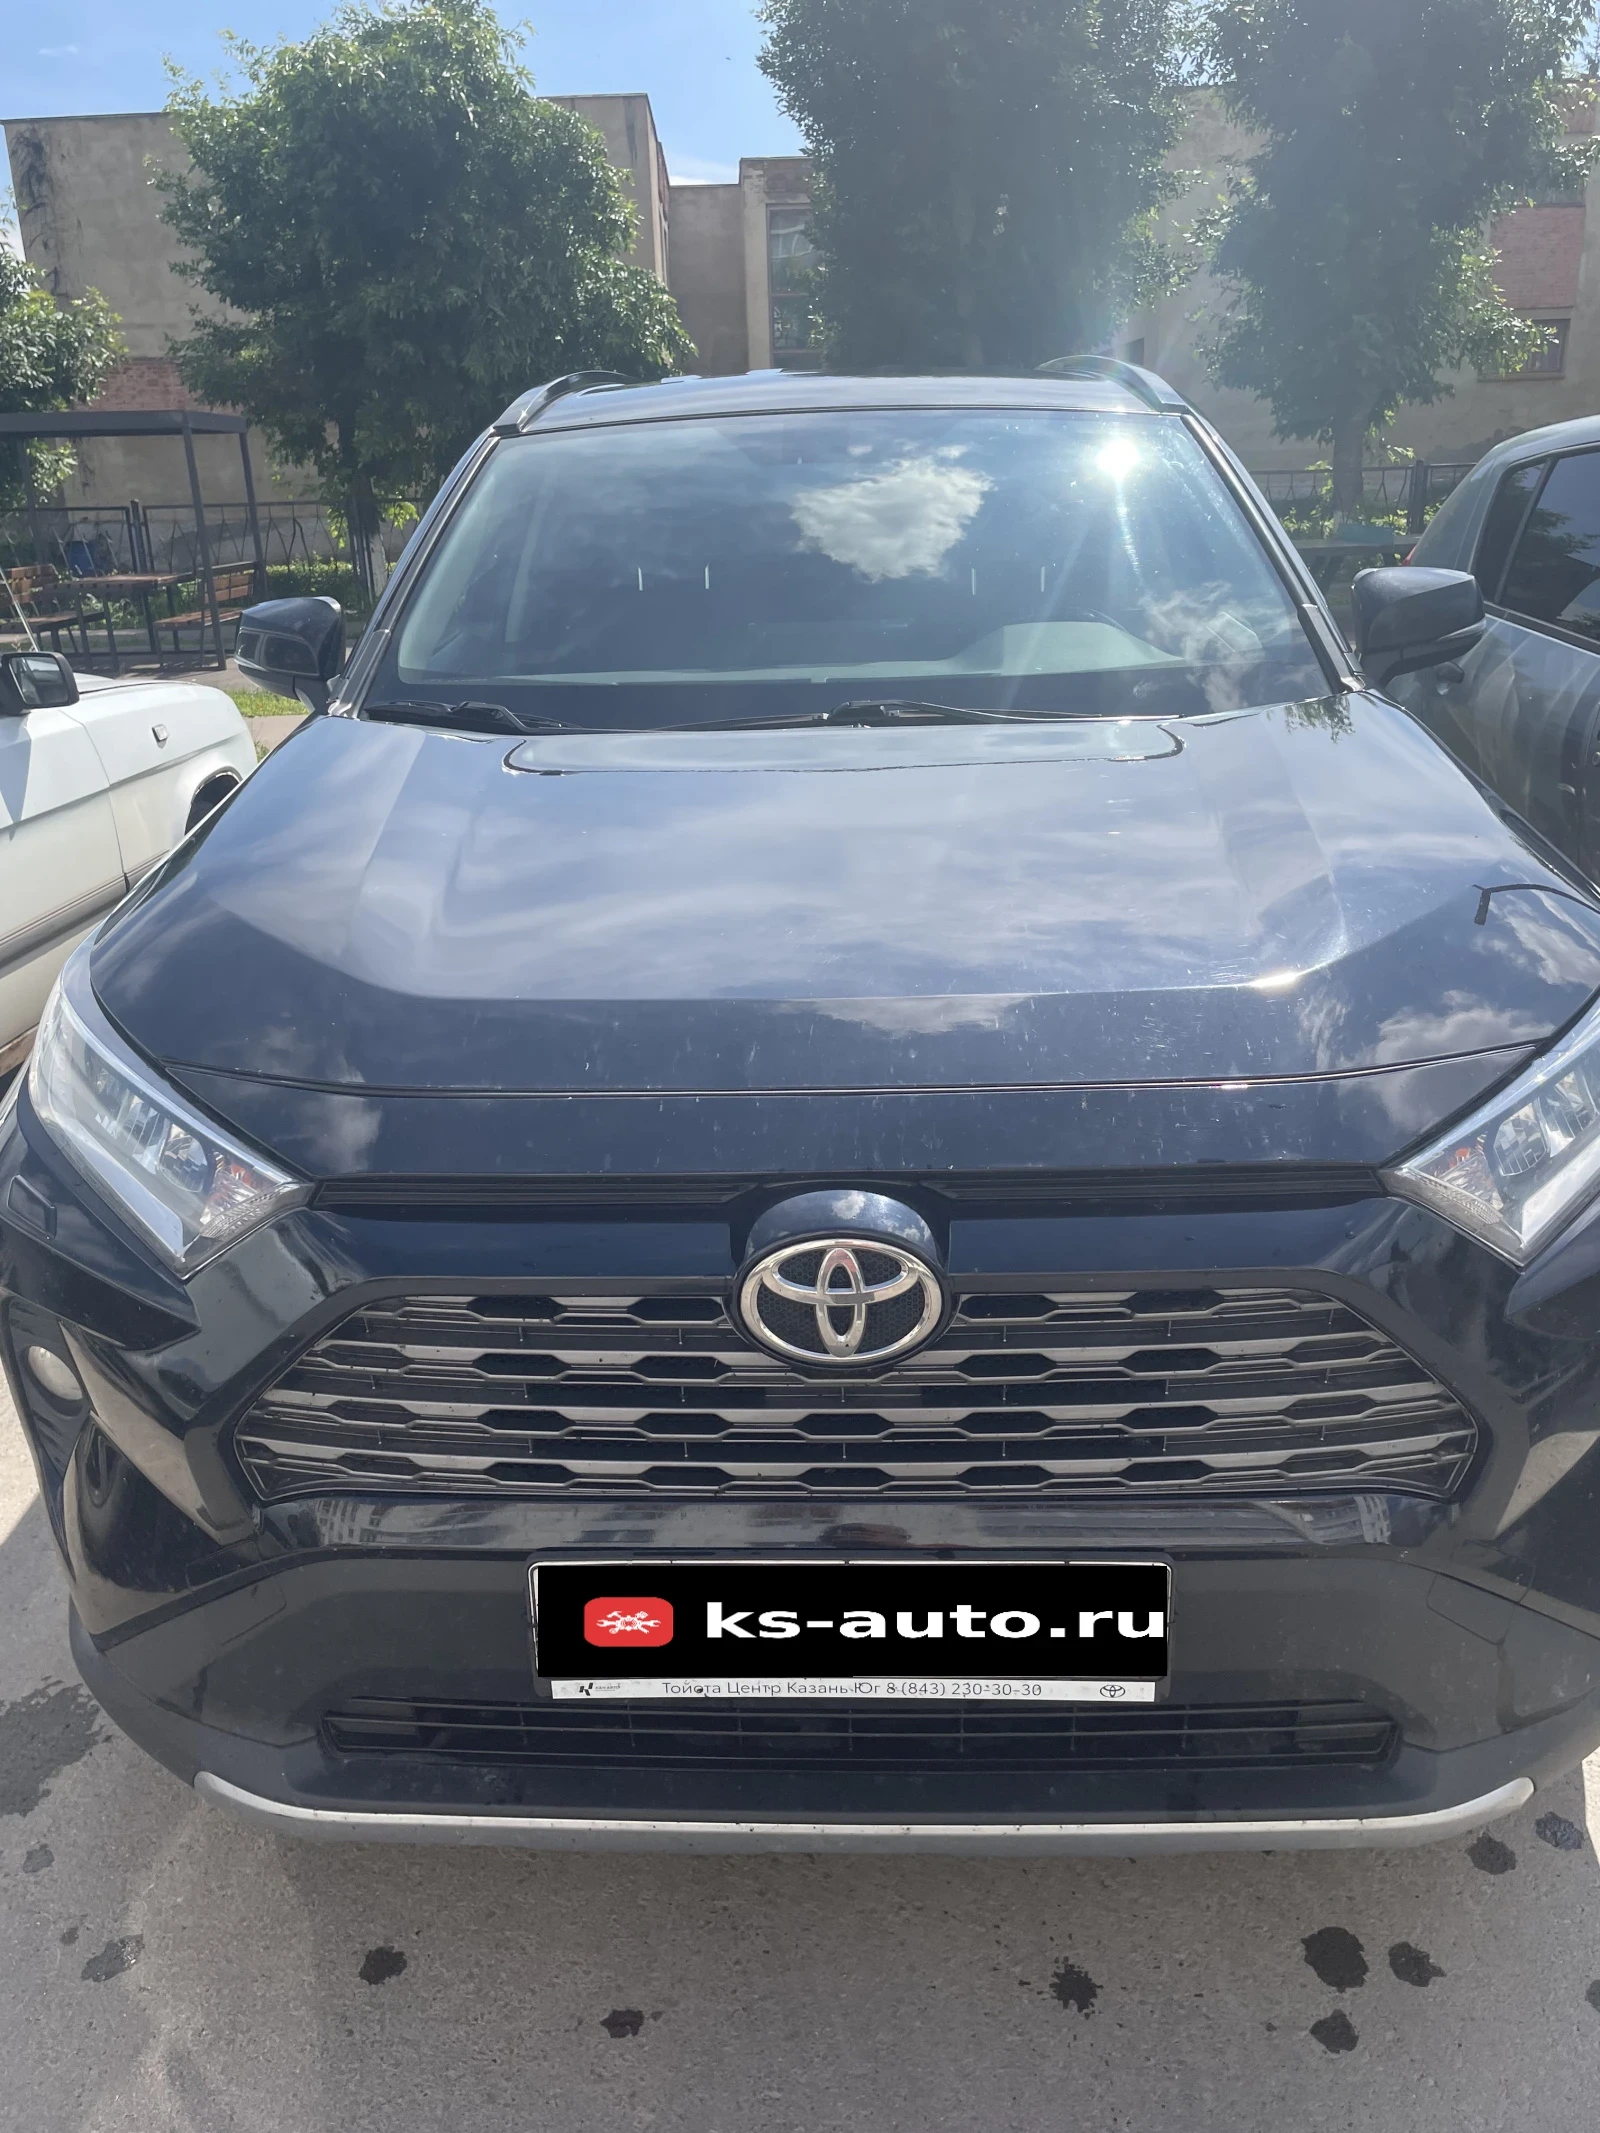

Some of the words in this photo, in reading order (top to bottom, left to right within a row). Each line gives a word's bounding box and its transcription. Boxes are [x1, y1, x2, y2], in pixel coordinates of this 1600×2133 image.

[662, 1680, 721, 1694] Тойота
[727, 1682, 782, 1697] Центр
[787, 1682, 849, 1694] Казань
[854, 1682, 881, 1694] Юг
[886, 1682, 896, 1695] 8
[901, 1682, 946, 1696] (843)
[951, 1682, 1042, 1696] 230-30-30
